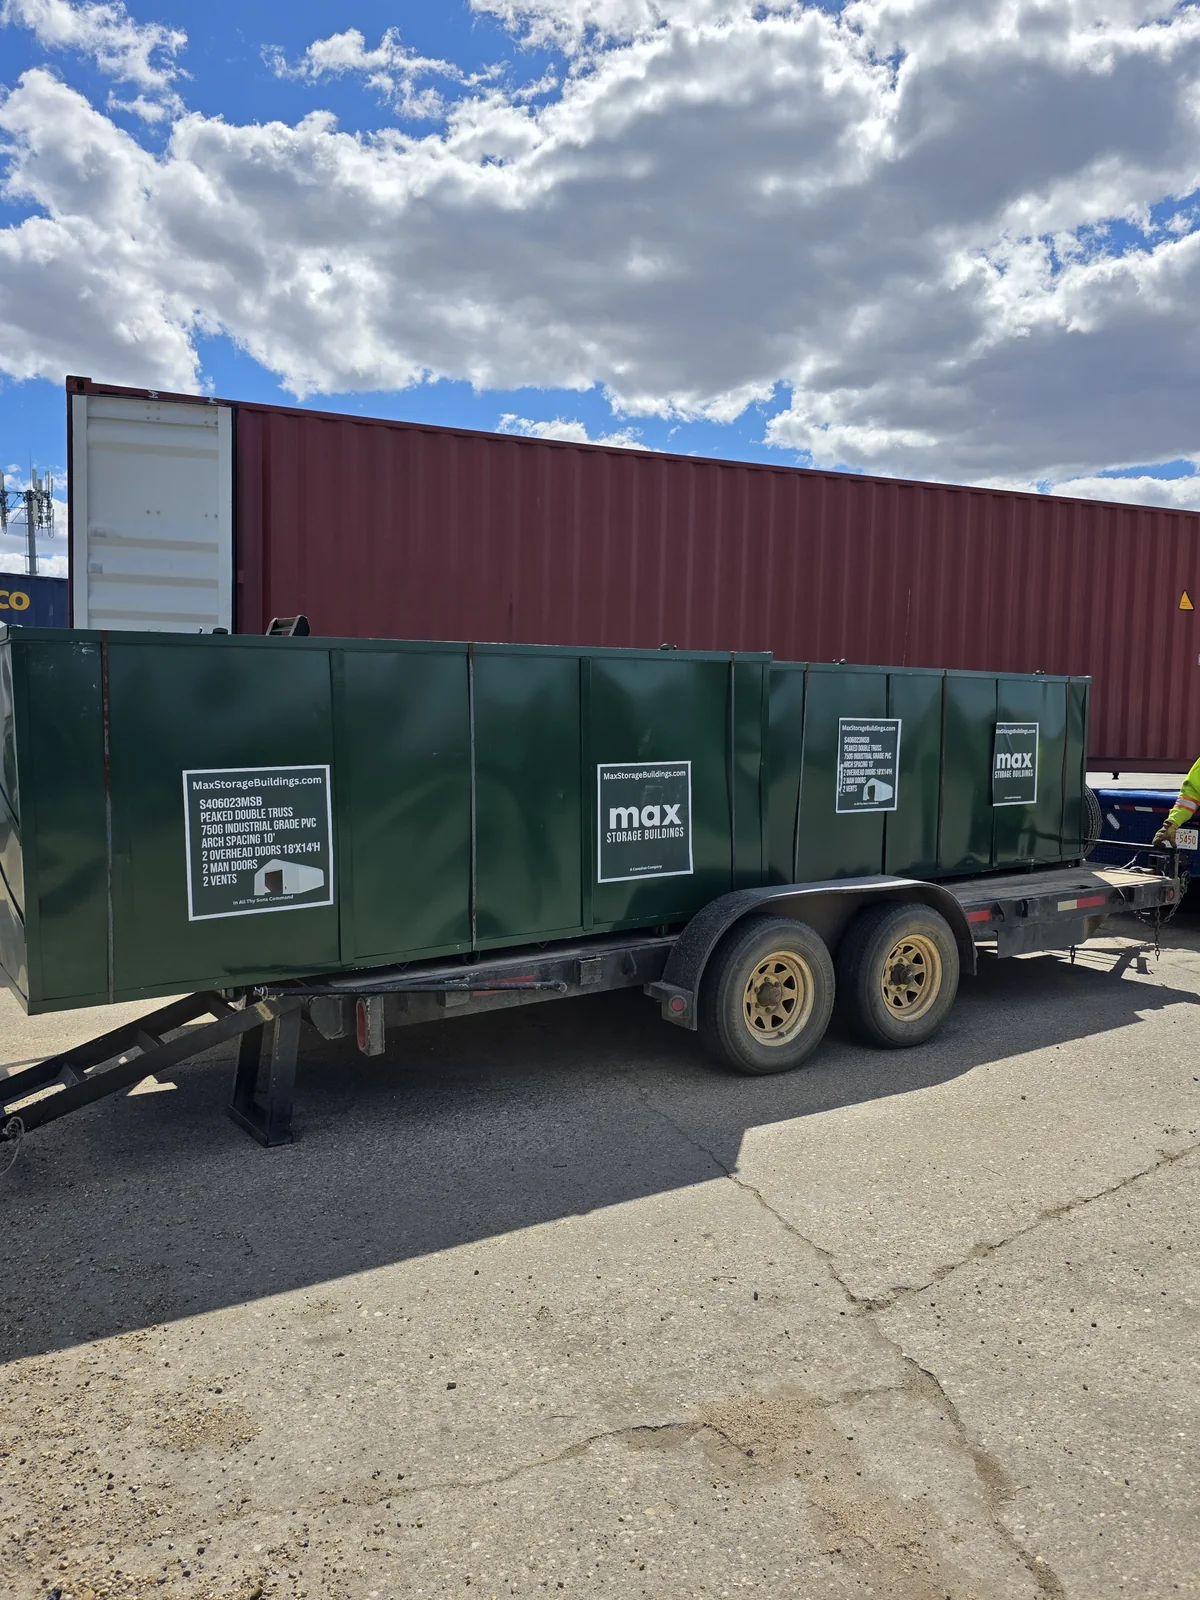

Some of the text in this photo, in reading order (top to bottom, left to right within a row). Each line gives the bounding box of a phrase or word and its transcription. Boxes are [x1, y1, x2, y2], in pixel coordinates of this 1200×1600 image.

[997, 753, 1032, 769] max
[604, 771, 686, 780] MaxStorageBuildings.com
[995, 770, 1011, 778] STORAGE
[193, 777, 322, 790] MaxStorageBuildings.com
[200, 796, 262, 810] S406023MSB
[201, 807, 293, 822] PEAKED DOUBLE TRUSS
[610, 804, 682, 829] max
[202, 818, 316, 835] 750G INDUSTRIAL GRADE PVC
[202, 833, 275, 848] ARCH SPACING 10'
[607, 827, 684, 843] STORAGE BUILDINGS
[202, 851, 208, 861] 2
[210, 848, 253, 860] OVERHEAD
[255, 845, 281, 857] DOORS
[203, 859, 258, 874] 2 MAN DOORS
[203, 874, 237, 887] 2 VENTS
